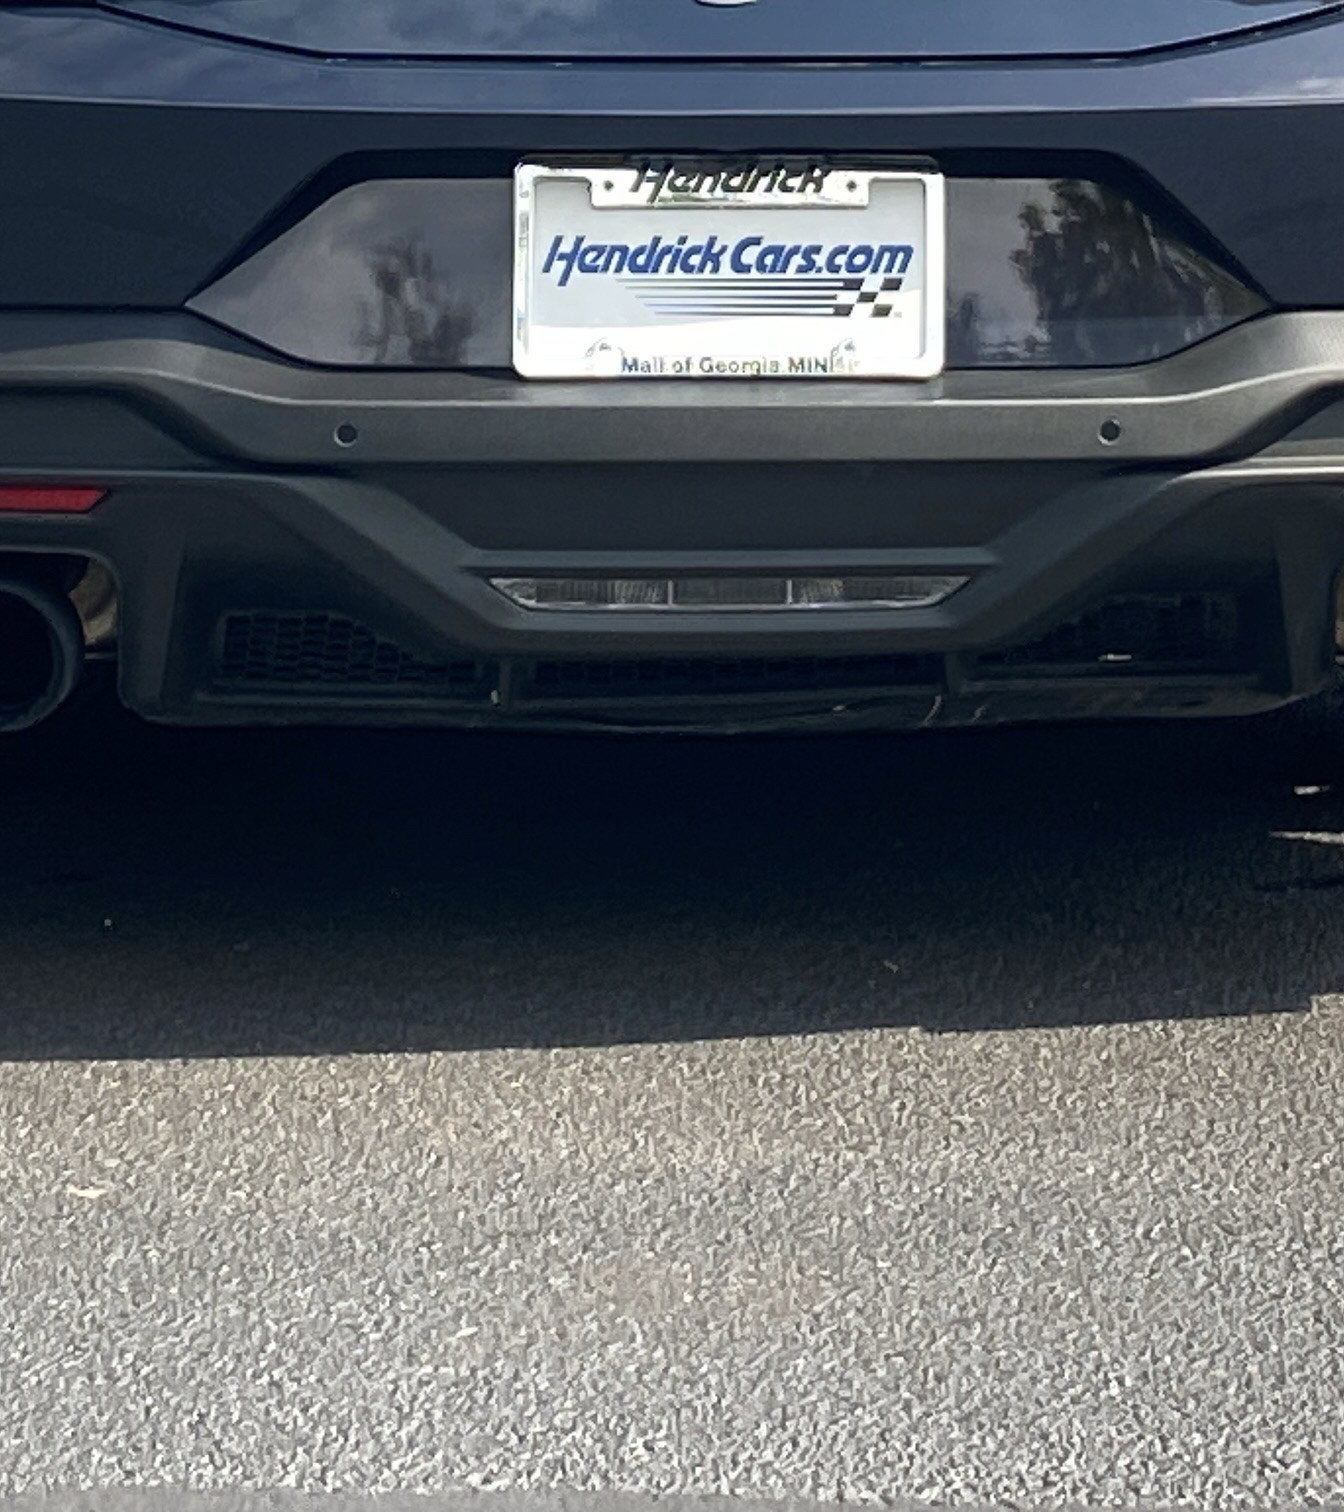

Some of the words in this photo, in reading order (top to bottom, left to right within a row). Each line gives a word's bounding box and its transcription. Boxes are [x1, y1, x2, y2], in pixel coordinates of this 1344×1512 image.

[629, 159, 826, 204] Hendrick
[542, 235, 914, 286] HendrickCars.com
[622, 357, 663, 373] Mall
[672, 357, 692, 373] of
[699, 357, 779, 376] Georgia
